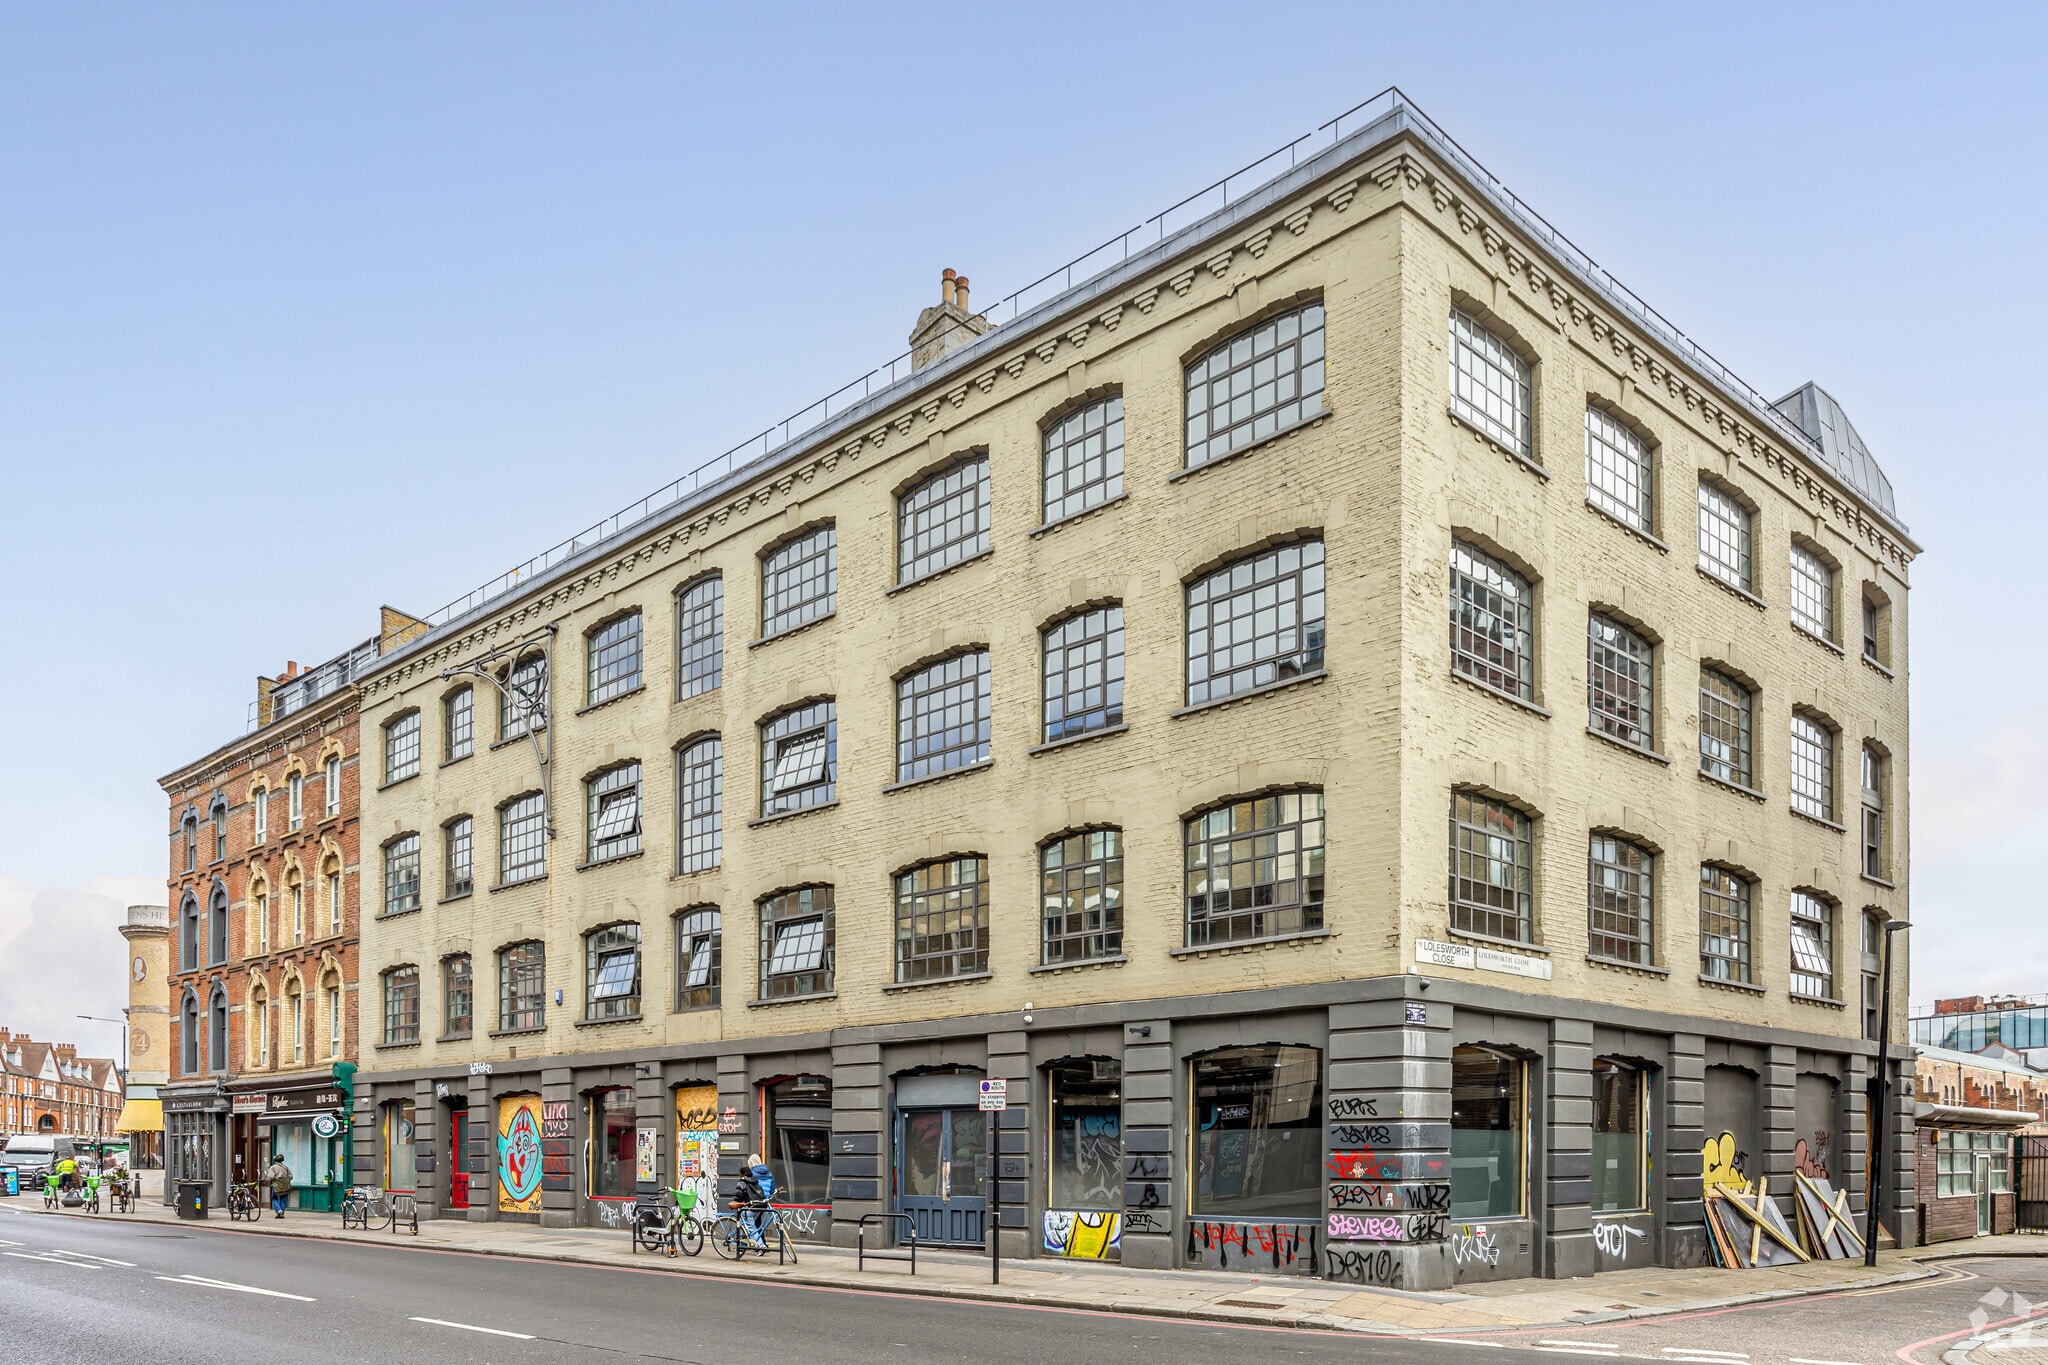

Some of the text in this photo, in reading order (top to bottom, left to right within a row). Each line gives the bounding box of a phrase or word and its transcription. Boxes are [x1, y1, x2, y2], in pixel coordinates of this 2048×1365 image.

[1423, 941, 1470, 957] LOLESWORTH
[1432, 952, 1455, 965] CLOSE
[1478, 951, 1513, 964] LOLESWORTH
[1514, 957, 1530, 967] CLOSE
